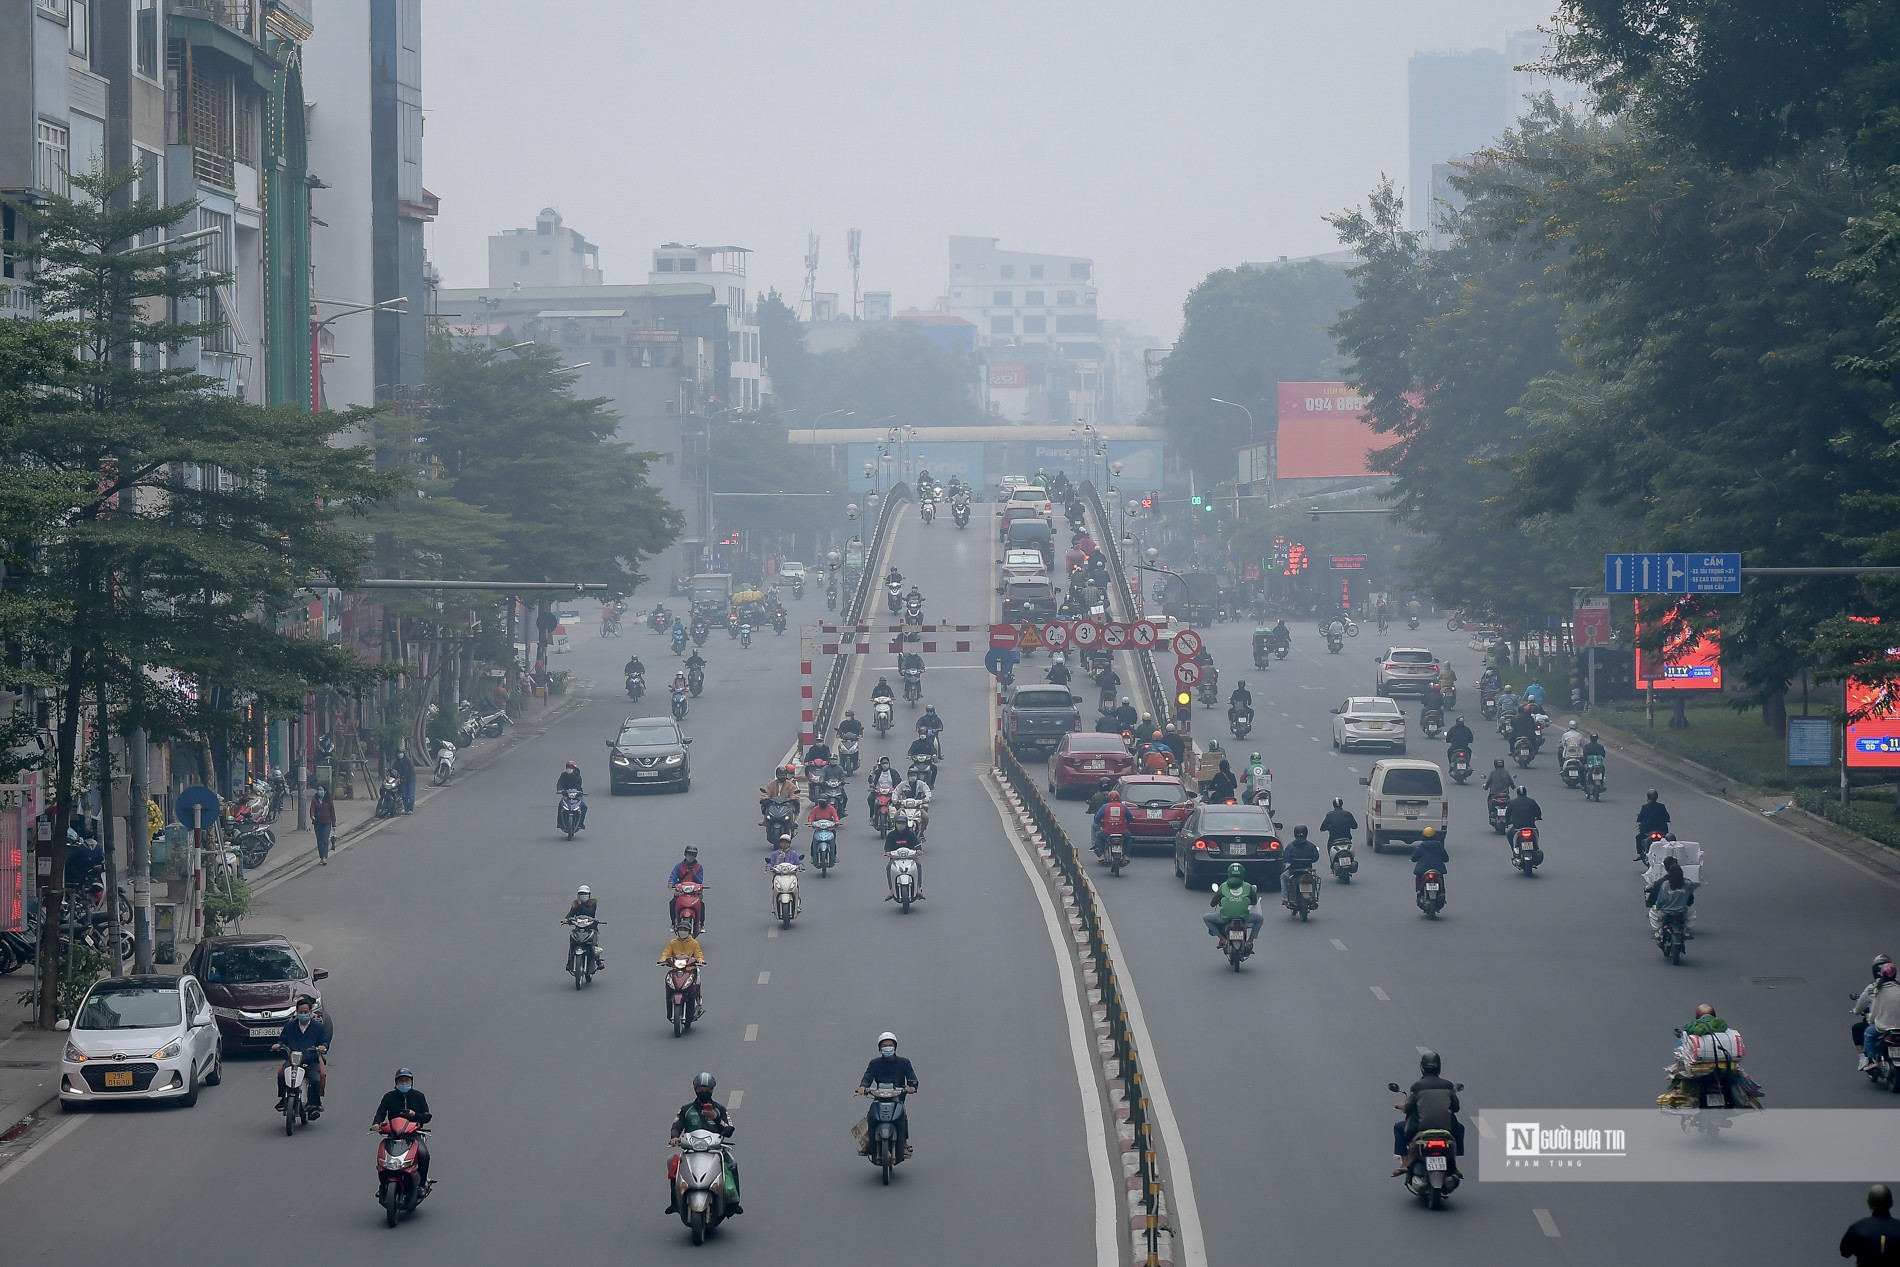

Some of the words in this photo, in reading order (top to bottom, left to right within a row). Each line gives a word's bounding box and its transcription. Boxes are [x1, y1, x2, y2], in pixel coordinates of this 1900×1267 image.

[1035, 446, 1106, 457] Panason
[1141, 499, 1152, 508] 92
[1191, 496, 1202, 505] 08
[1704, 556, 1724, 566] CẤM
